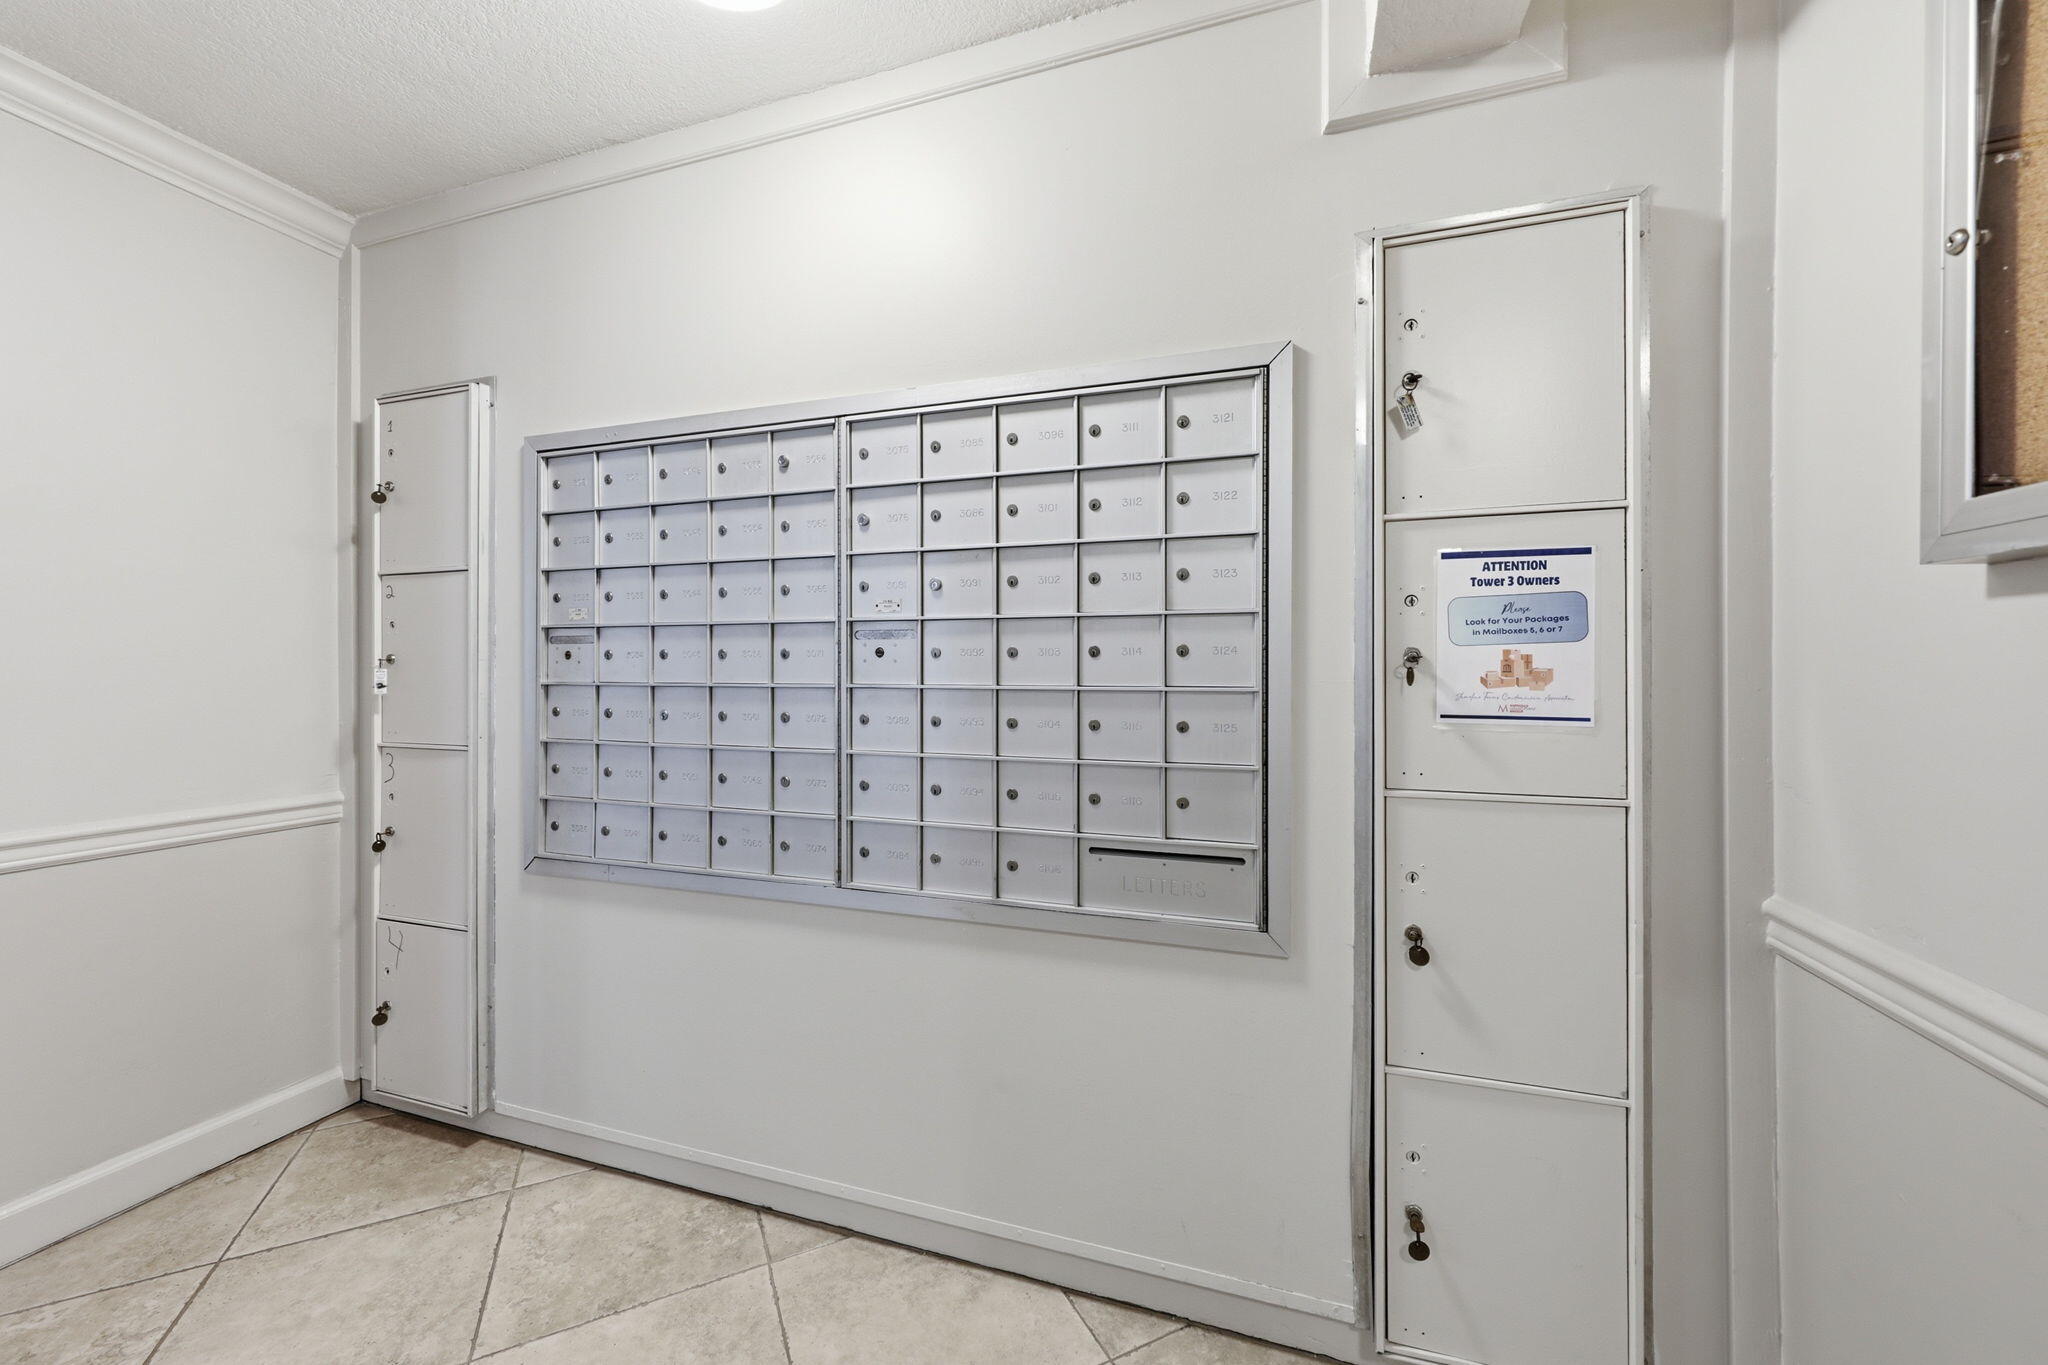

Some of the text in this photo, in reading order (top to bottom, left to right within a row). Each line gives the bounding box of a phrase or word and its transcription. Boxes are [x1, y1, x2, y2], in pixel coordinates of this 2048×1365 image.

[1211, 413, 1235, 424] 3121
[387, 420, 393, 433] 1
[1121, 422, 1139, 433] 3111
[1038, 430, 1065, 440] 3096
[1211, 490, 1239, 501] 3122
[1121, 496, 1144, 507] 3112
[959, 508, 985, 518] 3086
[1038, 503, 1059, 512] 3101
[1482, 560, 1547, 572] ATTENTION
[1120, 572, 1143, 581] 3113
[1211, 568, 1239, 578] 3123
[1037, 575, 1062, 585] 3102
[1470, 575, 1560, 587] Tower 3 Owners
[385, 584, 396, 599] 2
[1501, 601, 1533, 615] Please
[1465, 614, 1570, 626] Look for Your Packages
[1472, 628, 1481, 636] in
[1482, 626, 1529, 636] Mailboxes
[1529, 627, 1538, 635] 5,
[1539, 626, 1545, 634] 6
[1557, 625, 1563, 633] 7
[1120, 646, 1144, 656] 3114
[1212, 646, 1238, 656] 3124
[1212, 722, 1238, 734] 3125
[384, 752, 395, 784] 3
[1121, 875, 1208, 898] LETTERS
[387, 926, 404, 969] 4
